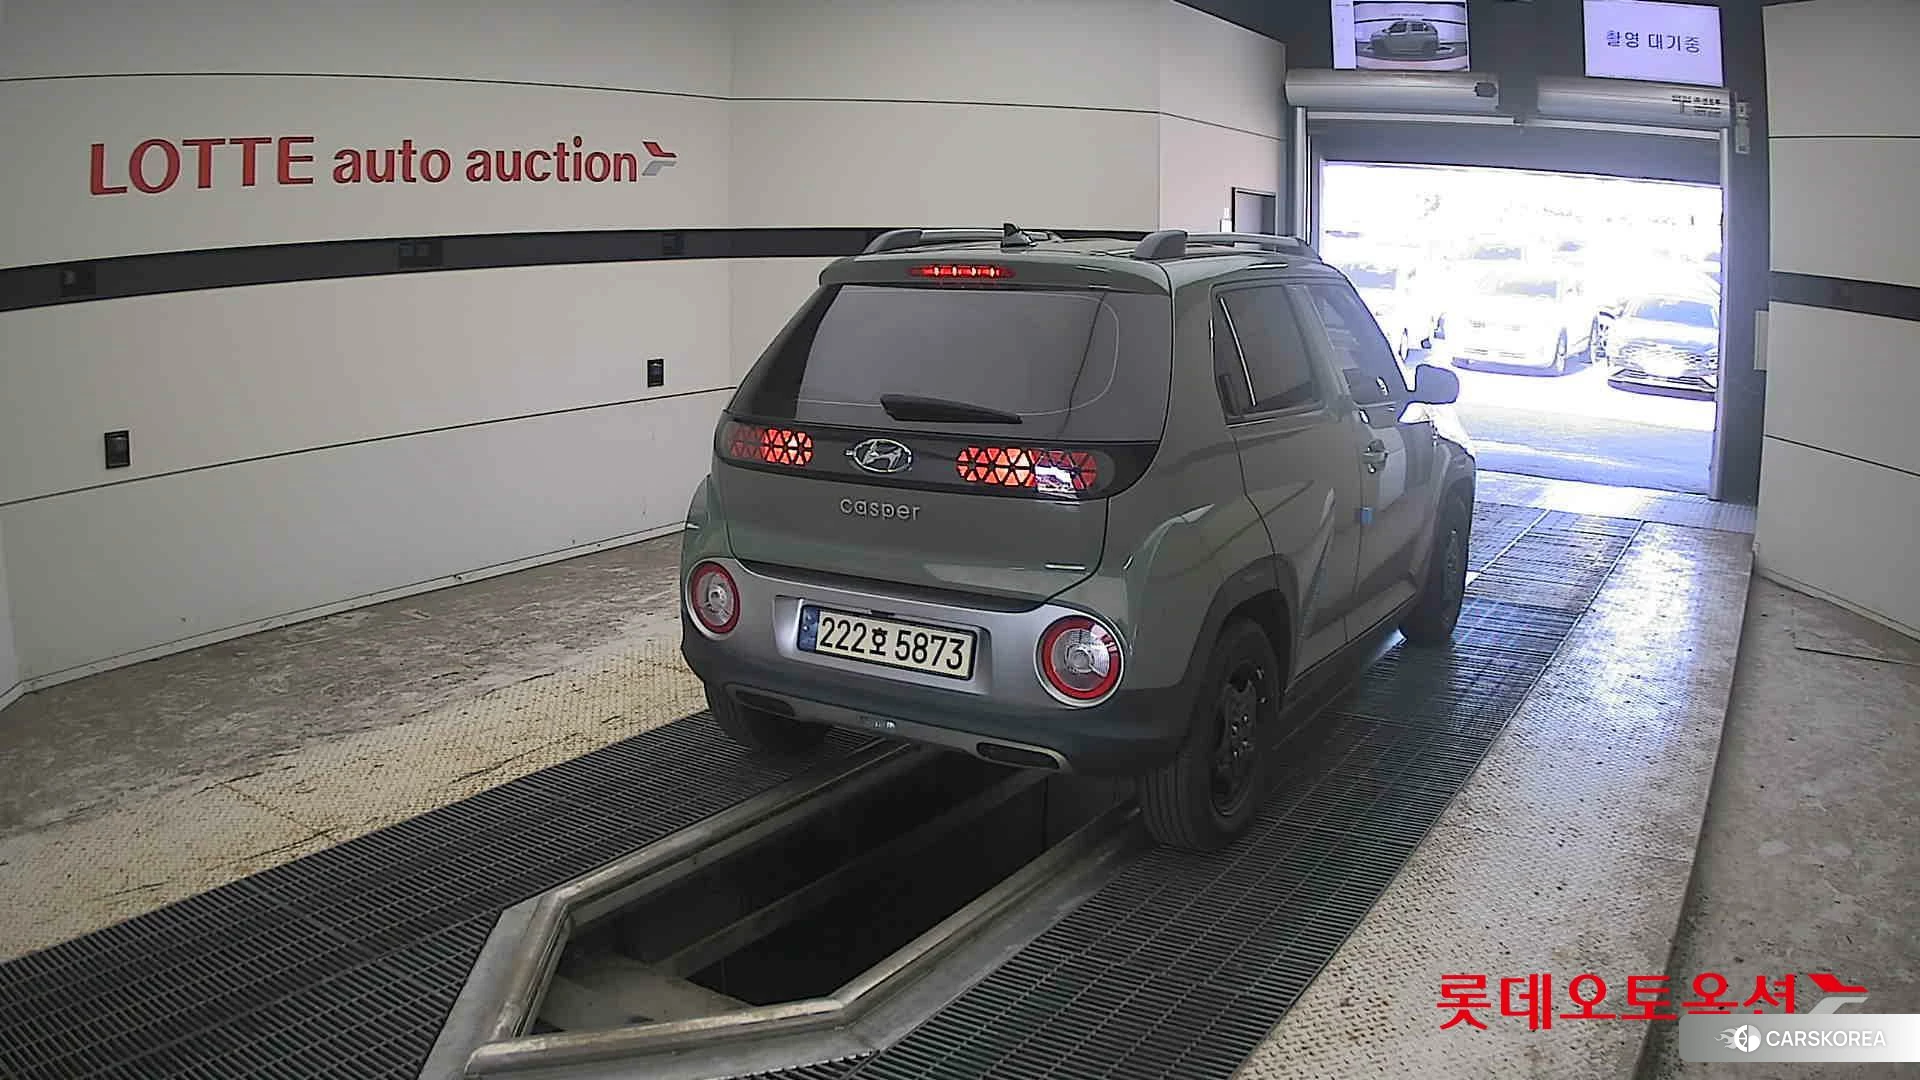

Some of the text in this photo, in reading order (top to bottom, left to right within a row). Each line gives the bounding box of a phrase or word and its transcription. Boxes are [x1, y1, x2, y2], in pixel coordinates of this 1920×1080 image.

[1647, 32, 1701, 54] 대기중
[90, 136, 638, 196] LOTTE auto auction
[840, 498, 921, 521] casper
[819, 616, 966, 670] 222호 5873
